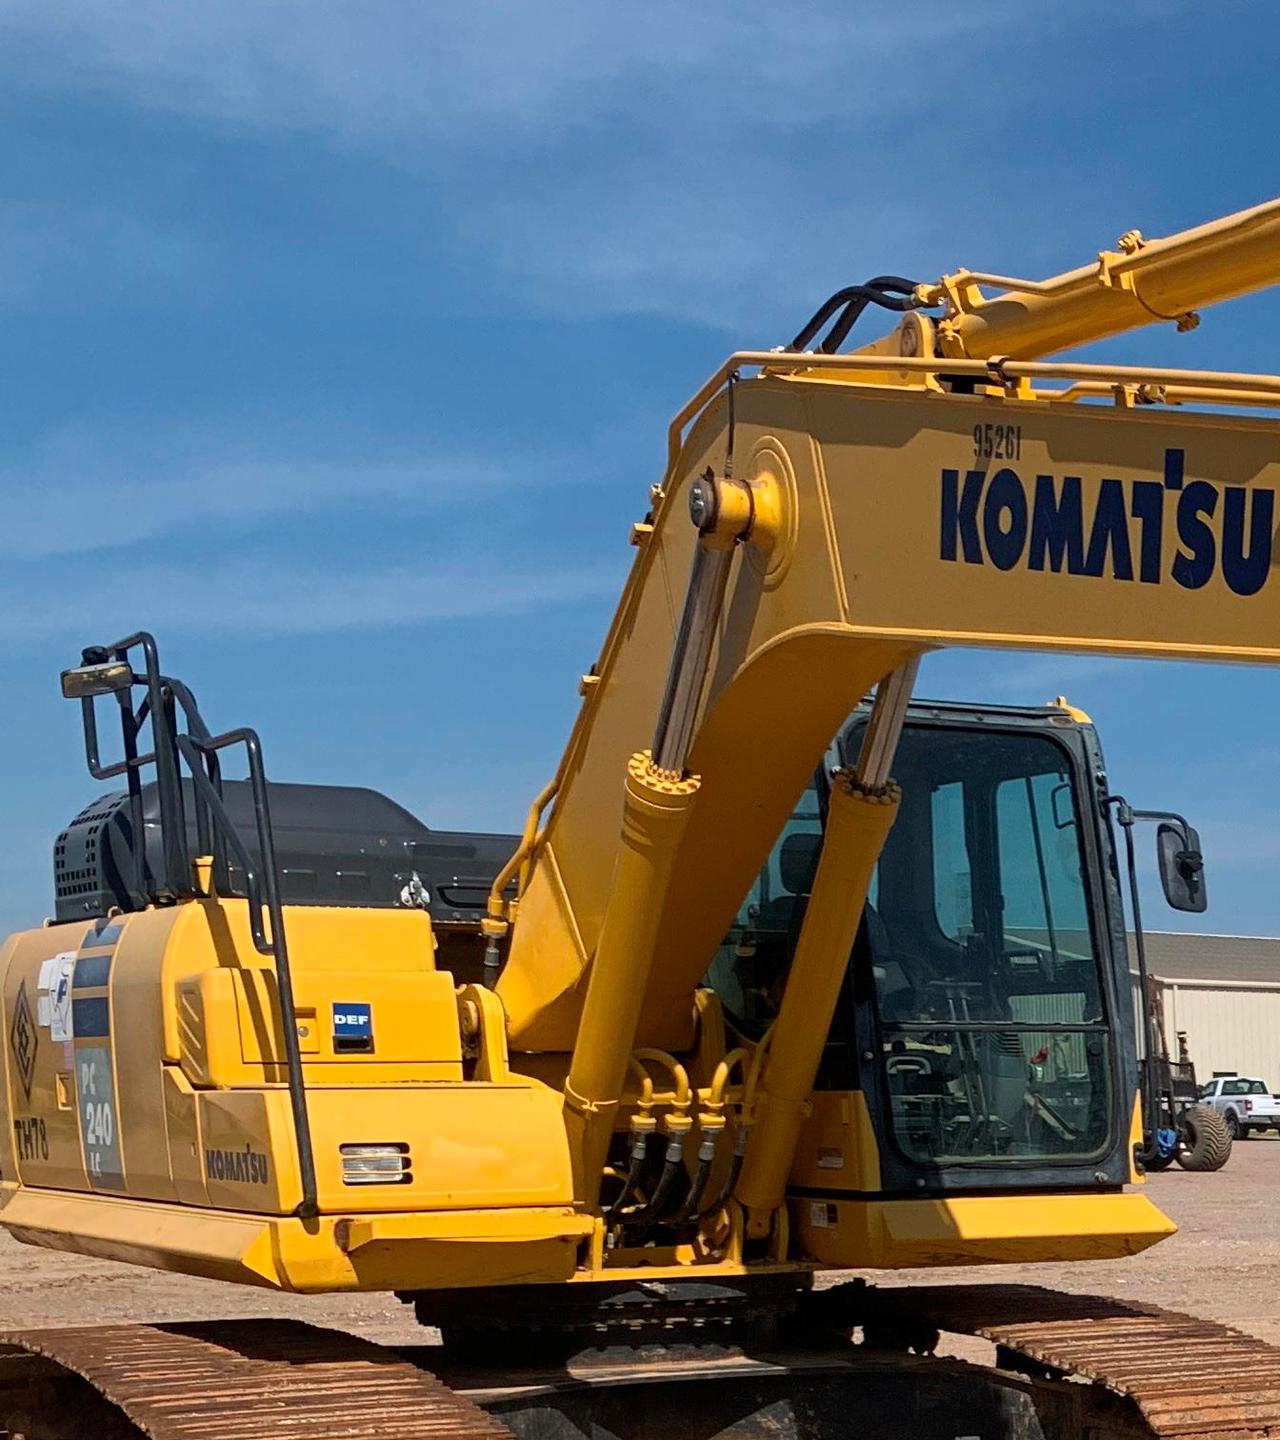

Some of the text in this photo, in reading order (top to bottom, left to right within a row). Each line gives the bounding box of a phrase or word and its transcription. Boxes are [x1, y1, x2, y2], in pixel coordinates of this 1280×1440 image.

[974, 424, 1020, 461] 95261
[940, 449, 1274, 596] KOMATSU
[334, 1014, 369, 1025] DEF
[81, 1063, 96, 1095] PC
[86, 1102, 112, 1146] 240
[206, 1143, 268, 1184] KOMATSU
